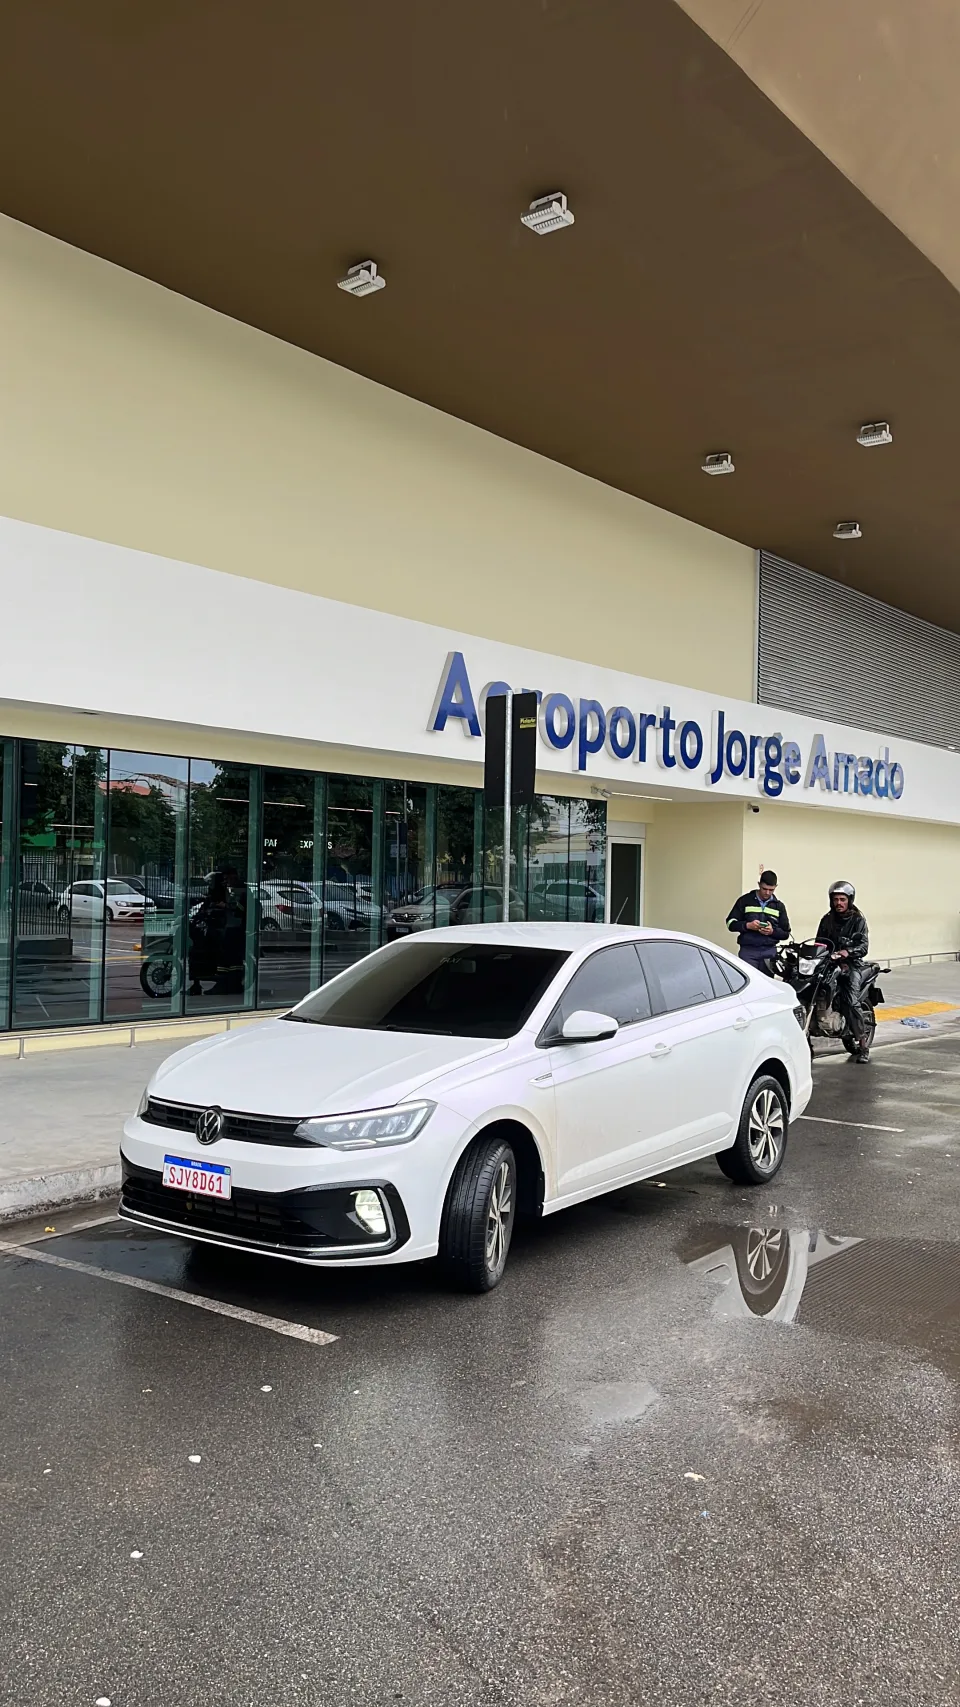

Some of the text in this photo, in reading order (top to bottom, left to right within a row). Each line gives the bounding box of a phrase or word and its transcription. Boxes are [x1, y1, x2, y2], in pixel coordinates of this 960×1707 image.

[427, 651, 904, 799] Aoporto Jorge Amado
[169, 1167, 222, 1194] SJY8D61
